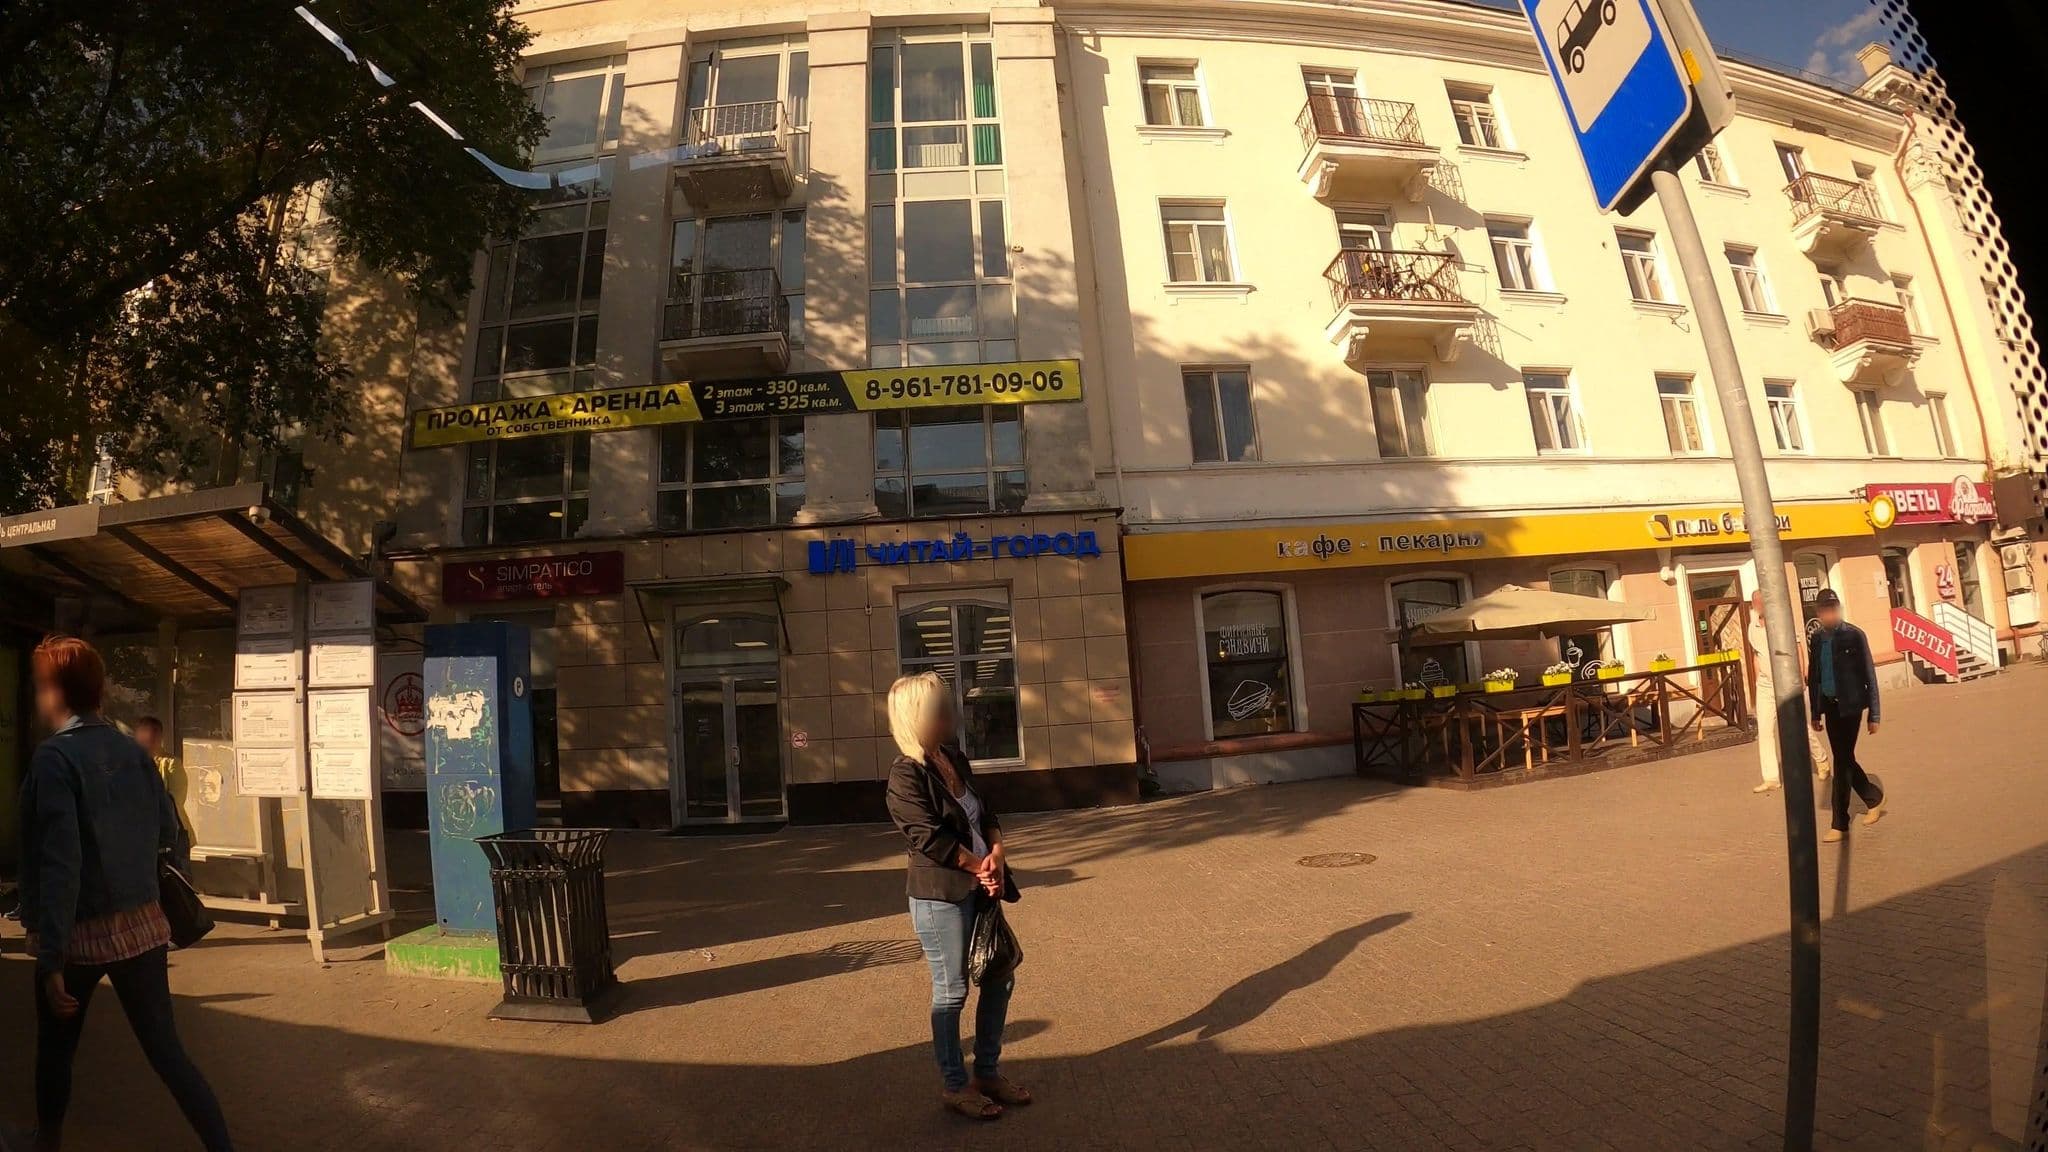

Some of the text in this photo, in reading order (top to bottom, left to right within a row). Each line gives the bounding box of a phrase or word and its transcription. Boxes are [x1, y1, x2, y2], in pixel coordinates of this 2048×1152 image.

[703, 385, 714, 399] 2
[716, 387, 754, 398] этаж
[766, 379, 797, 396] 330
[800, 382, 831, 394] кв.м.
[865, 370, 1064, 401] 8-961-781-09-06
[427, 388, 681, 430] ПРОДАЖА АРЕНДА
[714, 400, 725, 414] 3
[728, 402, 765, 414] этаж
[778, 394, 809, 411] 325
[811, 396, 843, 408] кв.м.
[486, 415, 611, 437] ОТ СОБСТВЕННИКА
[7, 519, 57, 538] ЦЕНТРАЛЬНАЯ
[866, 530, 1102, 565] ЧИТАЙ-ГОРОД
[1277, 531, 1484, 560] кафе пекарня
[496, 560, 593, 582] SIMPATICO
[1936, 565, 1954, 587] 24
[1219, 636, 1270, 655] СЭНДВИЧИ
[1893, 617, 1953, 659] ЦВЕТЫ
